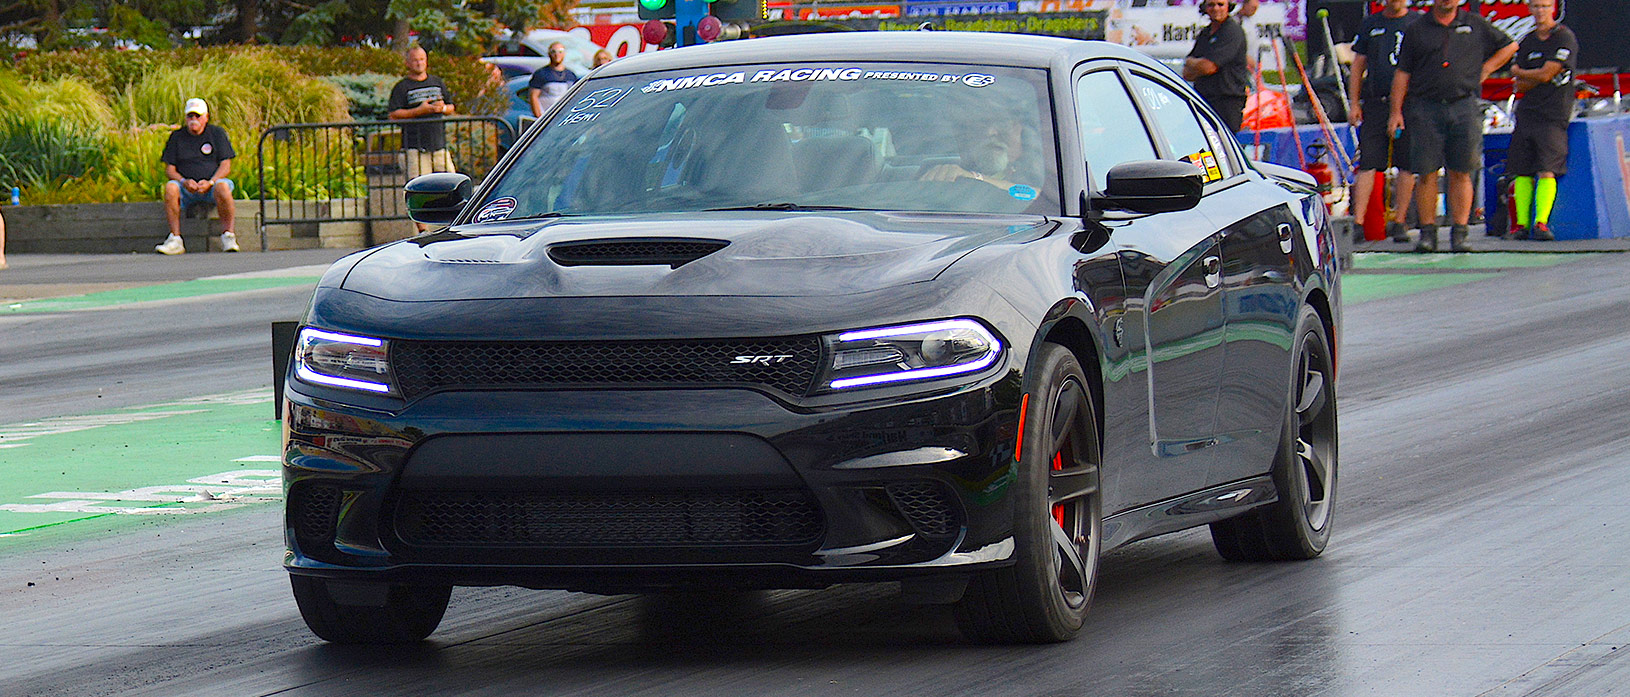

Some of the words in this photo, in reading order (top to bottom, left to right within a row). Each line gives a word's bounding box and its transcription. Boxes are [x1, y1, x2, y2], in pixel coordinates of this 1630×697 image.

[654, 72, 746, 92] NMCA
[750, 67, 863, 84] RACING
[864, 71, 938, 82] PRESENTED
[940, 74, 960, 83] BY
[570, 87, 635, 113] 521
[558, 112, 601, 126] HEMI
[729, 354, 794, 367] SRT
